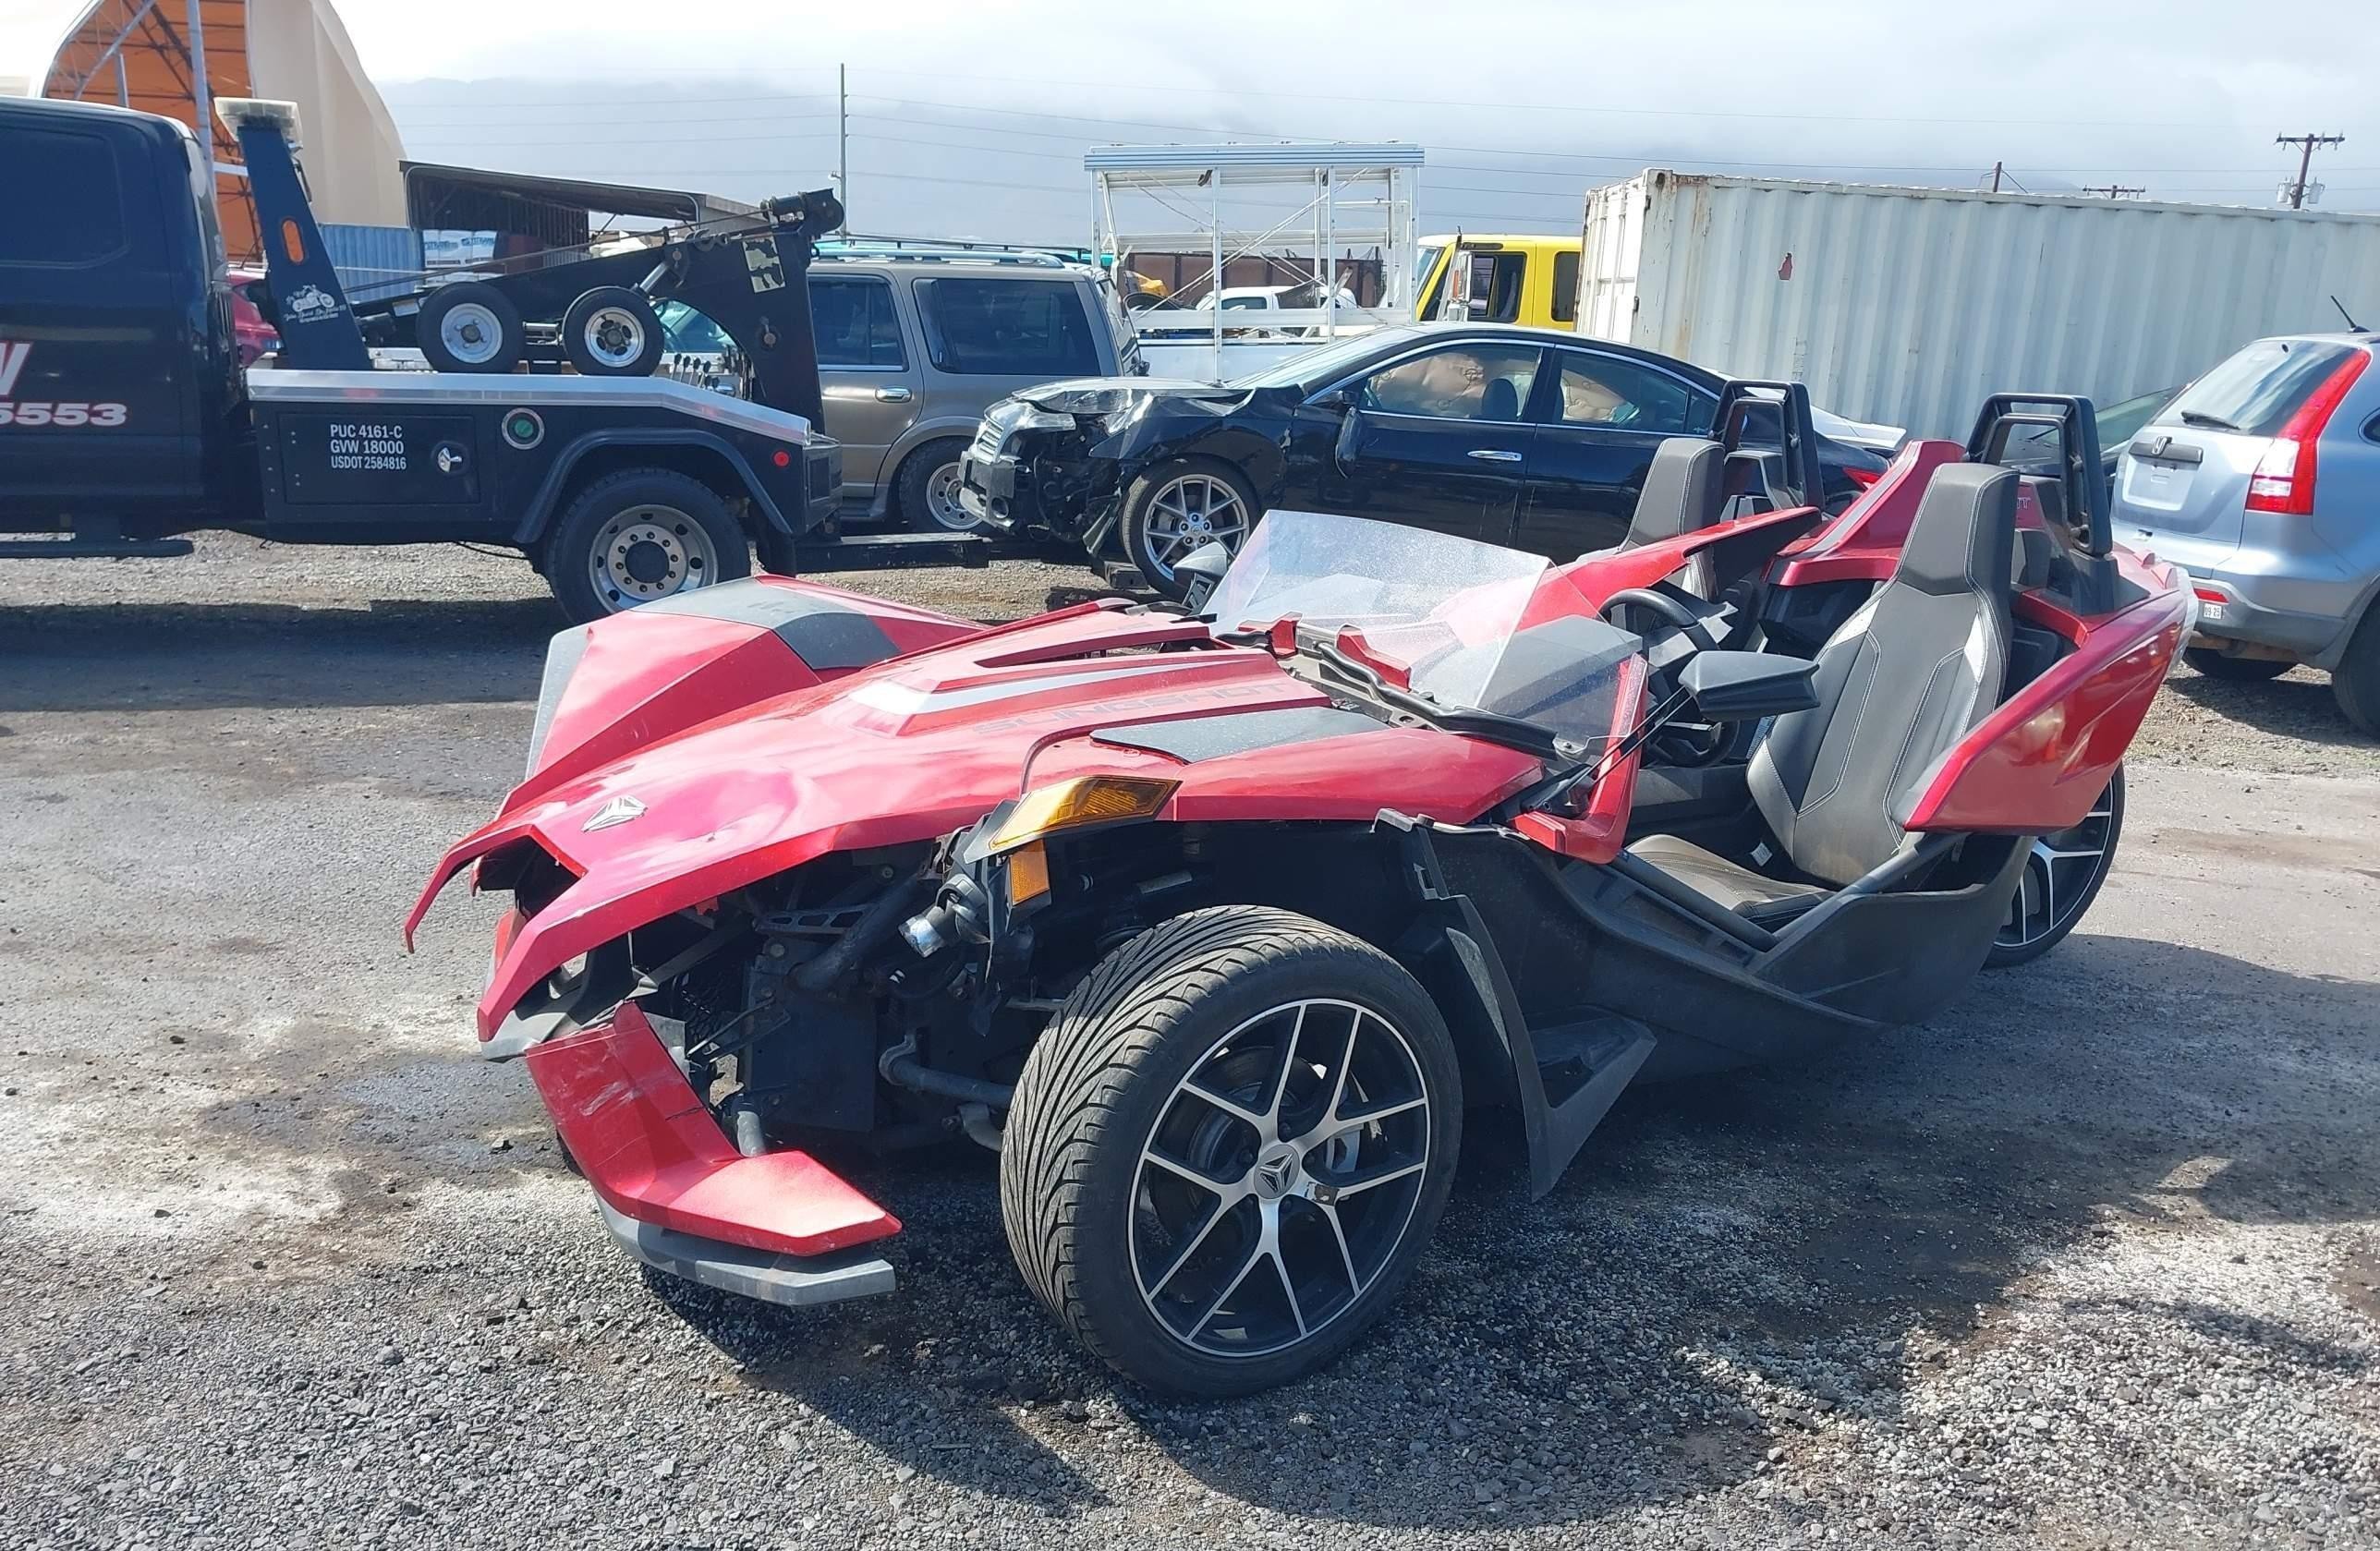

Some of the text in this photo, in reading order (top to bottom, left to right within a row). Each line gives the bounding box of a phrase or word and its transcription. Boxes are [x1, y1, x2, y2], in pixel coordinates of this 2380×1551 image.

[330, 424, 403, 439] PUC 4161-C
[330, 440, 405, 454] GVW 18000
[331, 455, 407, 470] USDOT 2584816
[972, 682, 1285, 735] SLINGSHOT
